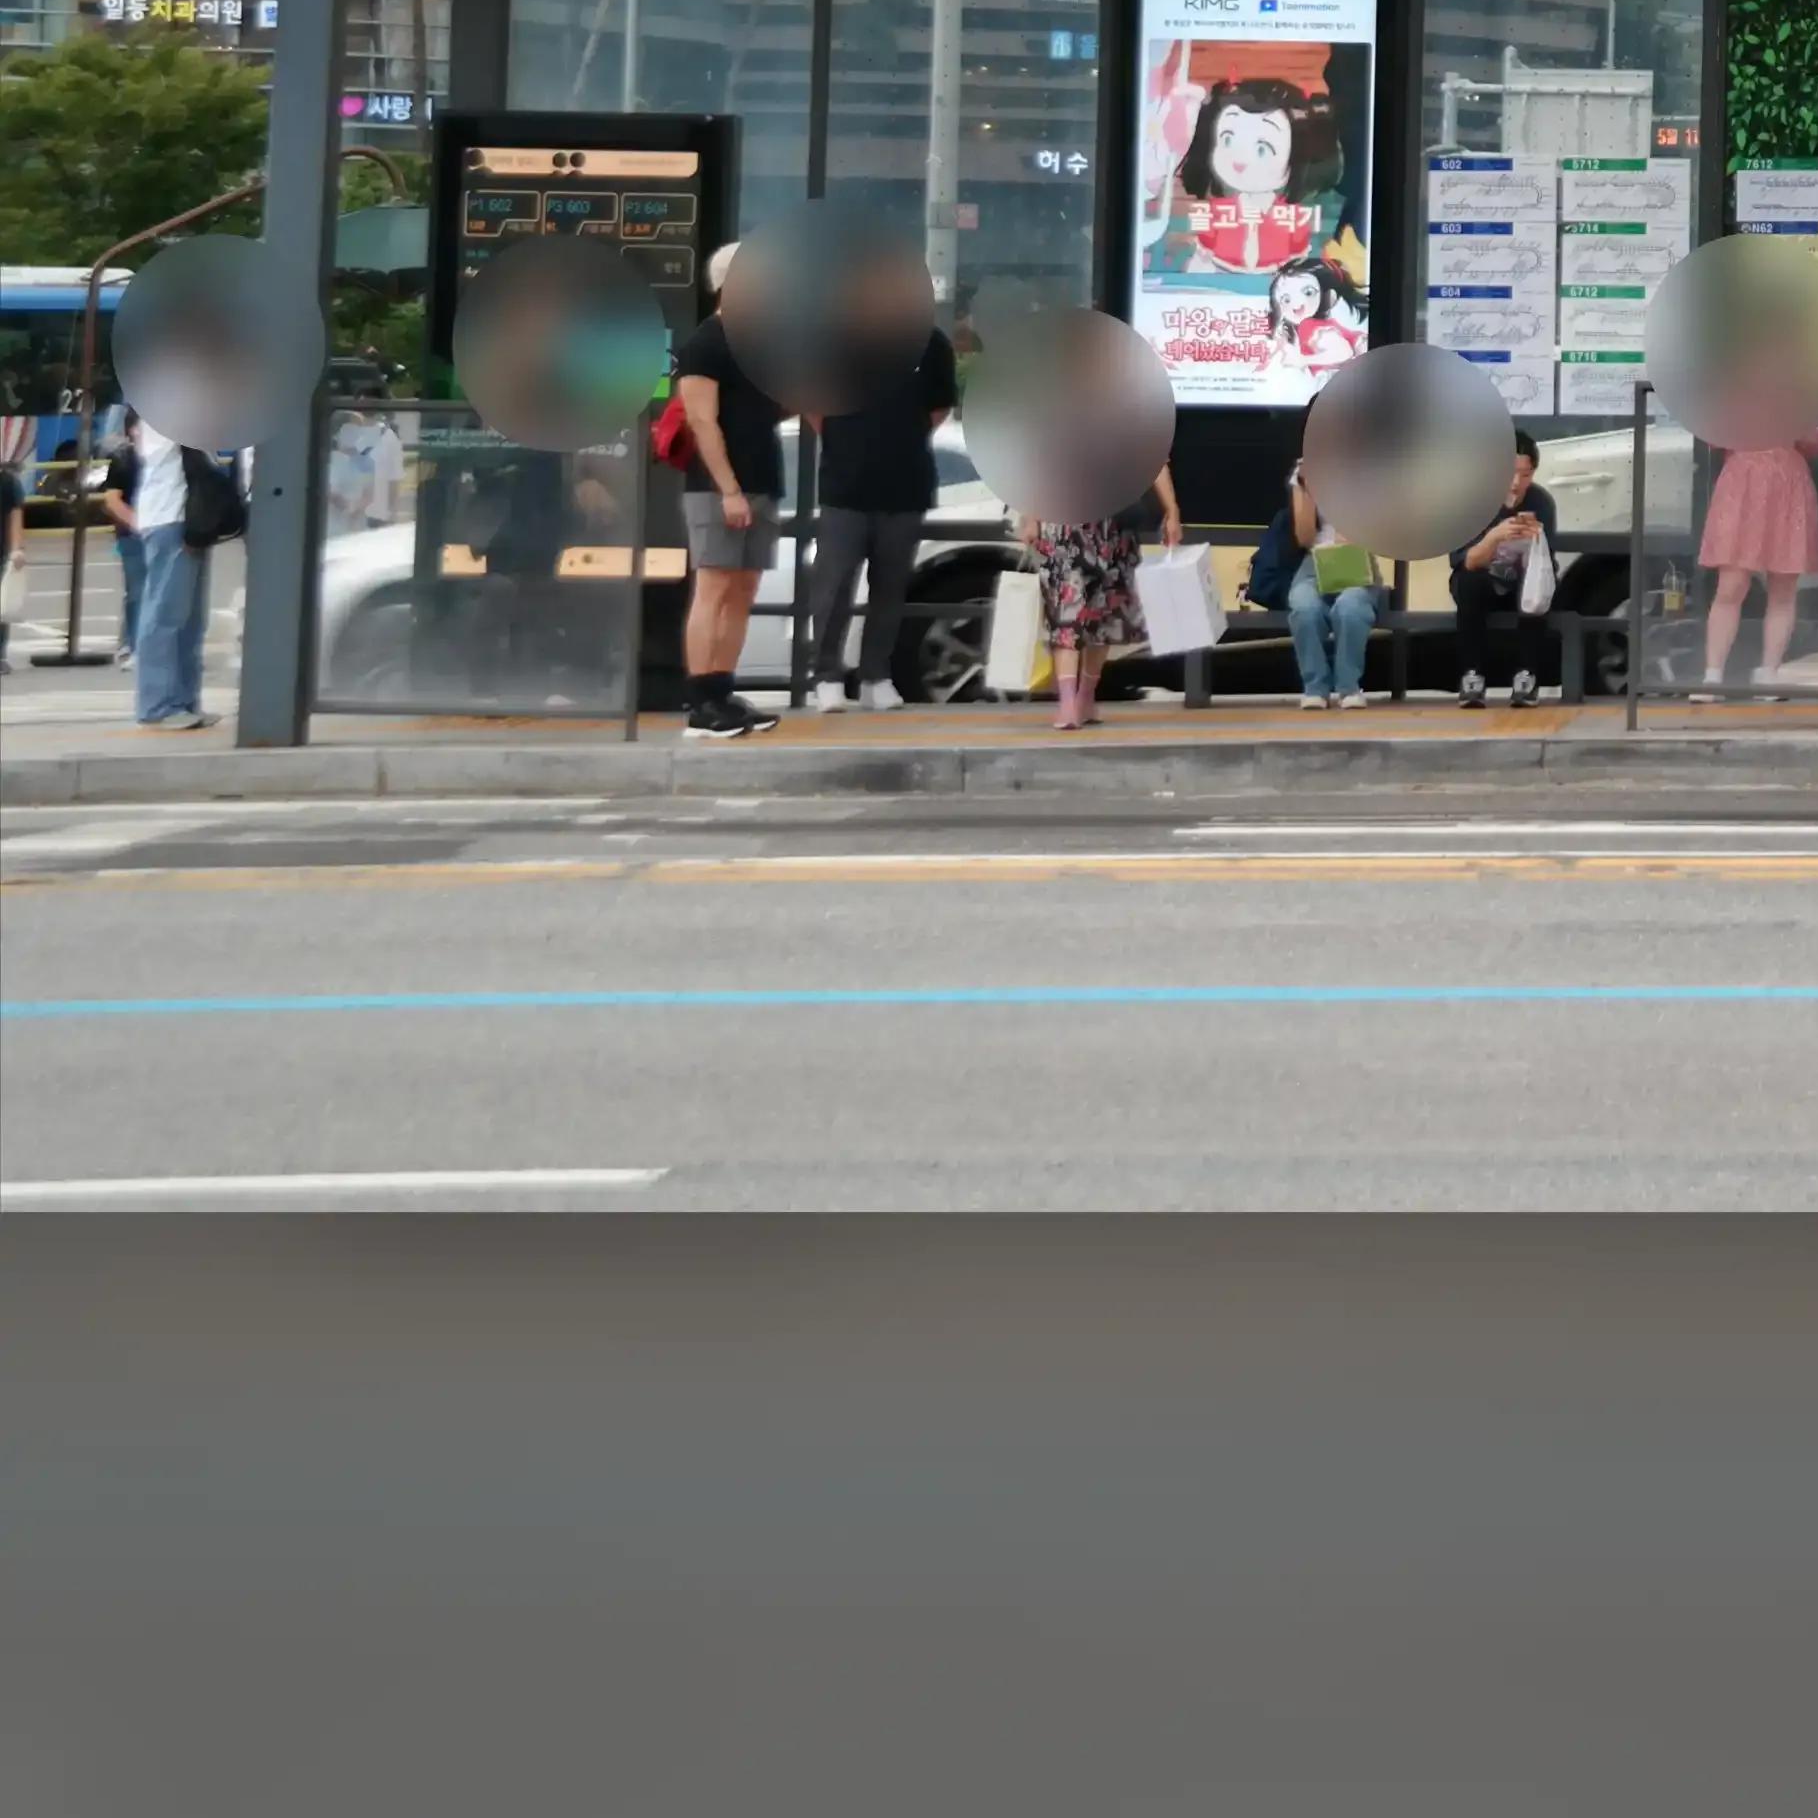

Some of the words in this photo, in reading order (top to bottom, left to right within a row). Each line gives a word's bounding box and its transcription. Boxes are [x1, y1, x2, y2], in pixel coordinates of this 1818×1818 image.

[1441, 160, 1462, 171] 602
[1746, 159, 1774, 170] 7612
[1188, 203, 1264, 232] 골고루
[1273, 204, 1322, 233] 먹기
